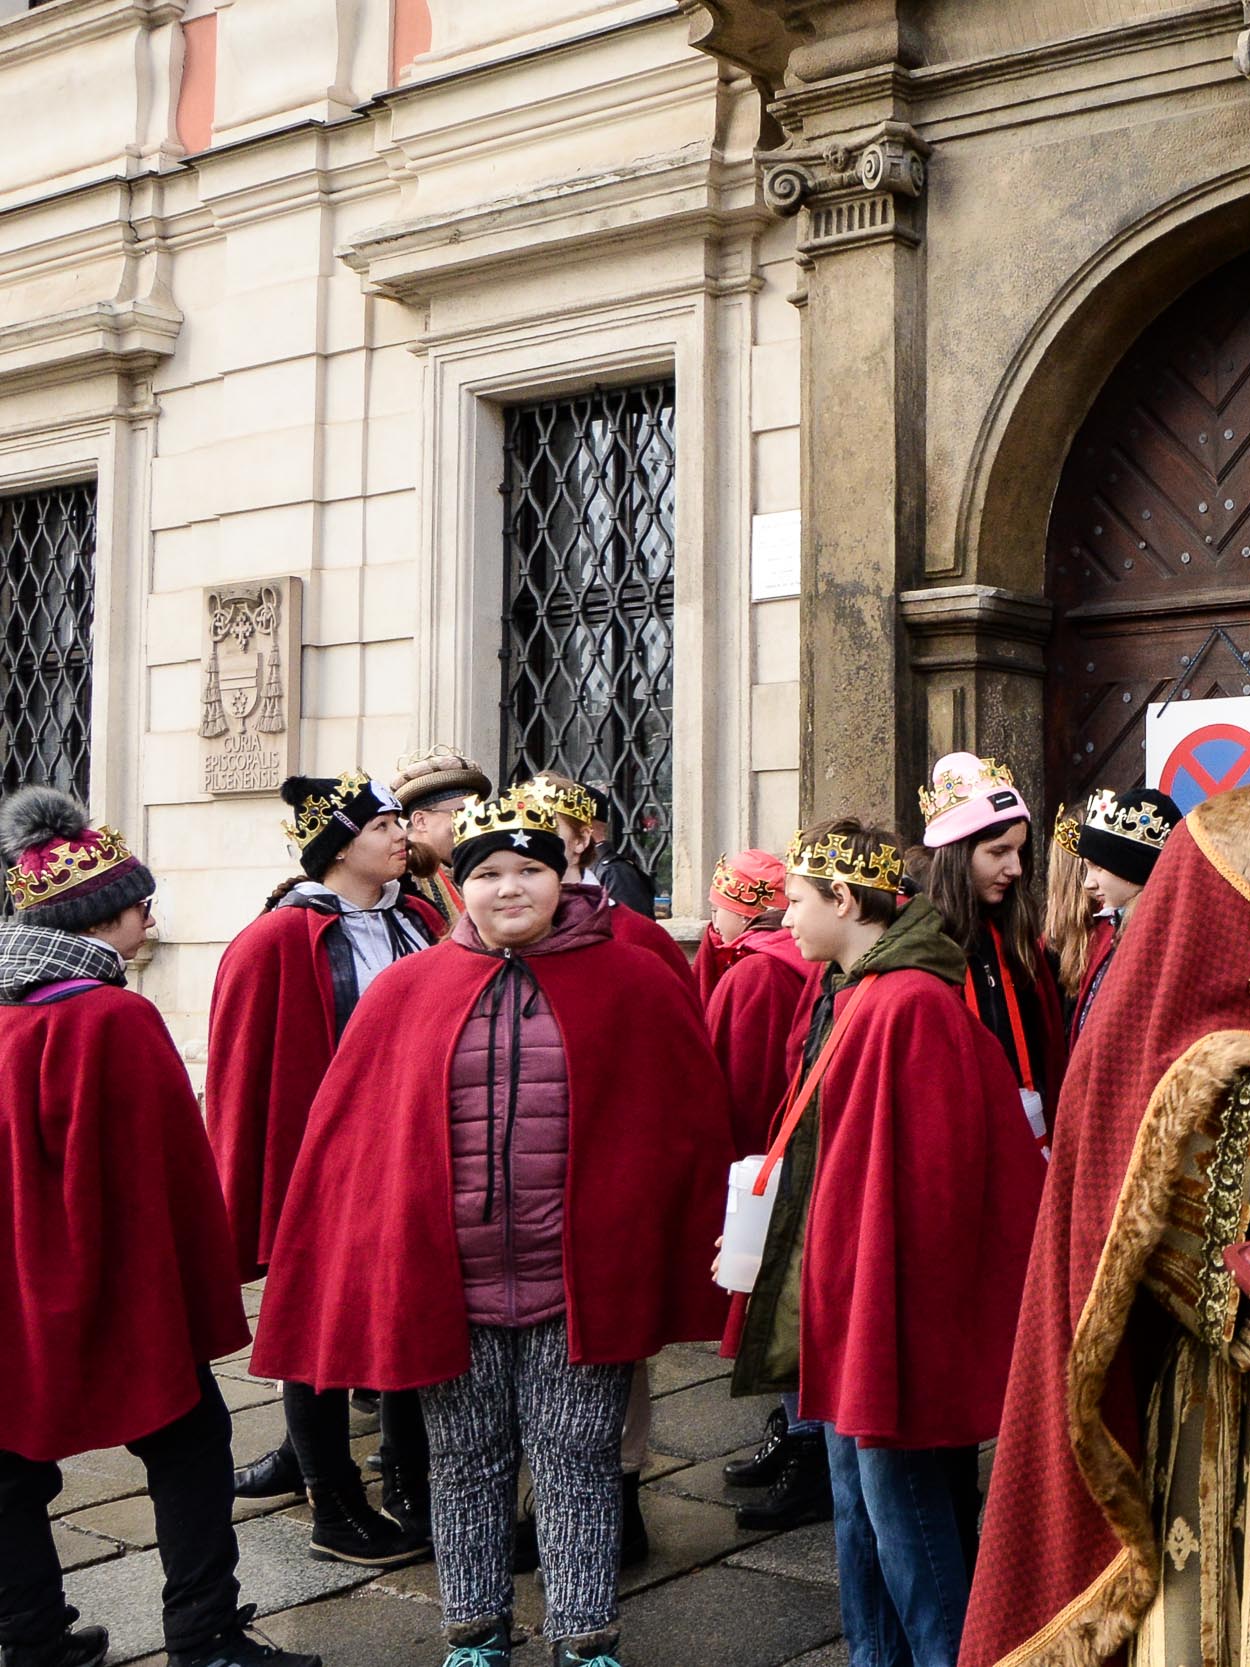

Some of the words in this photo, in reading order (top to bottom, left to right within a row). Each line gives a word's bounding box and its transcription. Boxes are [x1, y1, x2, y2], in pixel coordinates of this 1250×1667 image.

[224, 735, 261, 753] CURIA
[204, 752, 279, 773] EPISCOPALIS
[204, 770, 279, 791] PILSENENSIS
